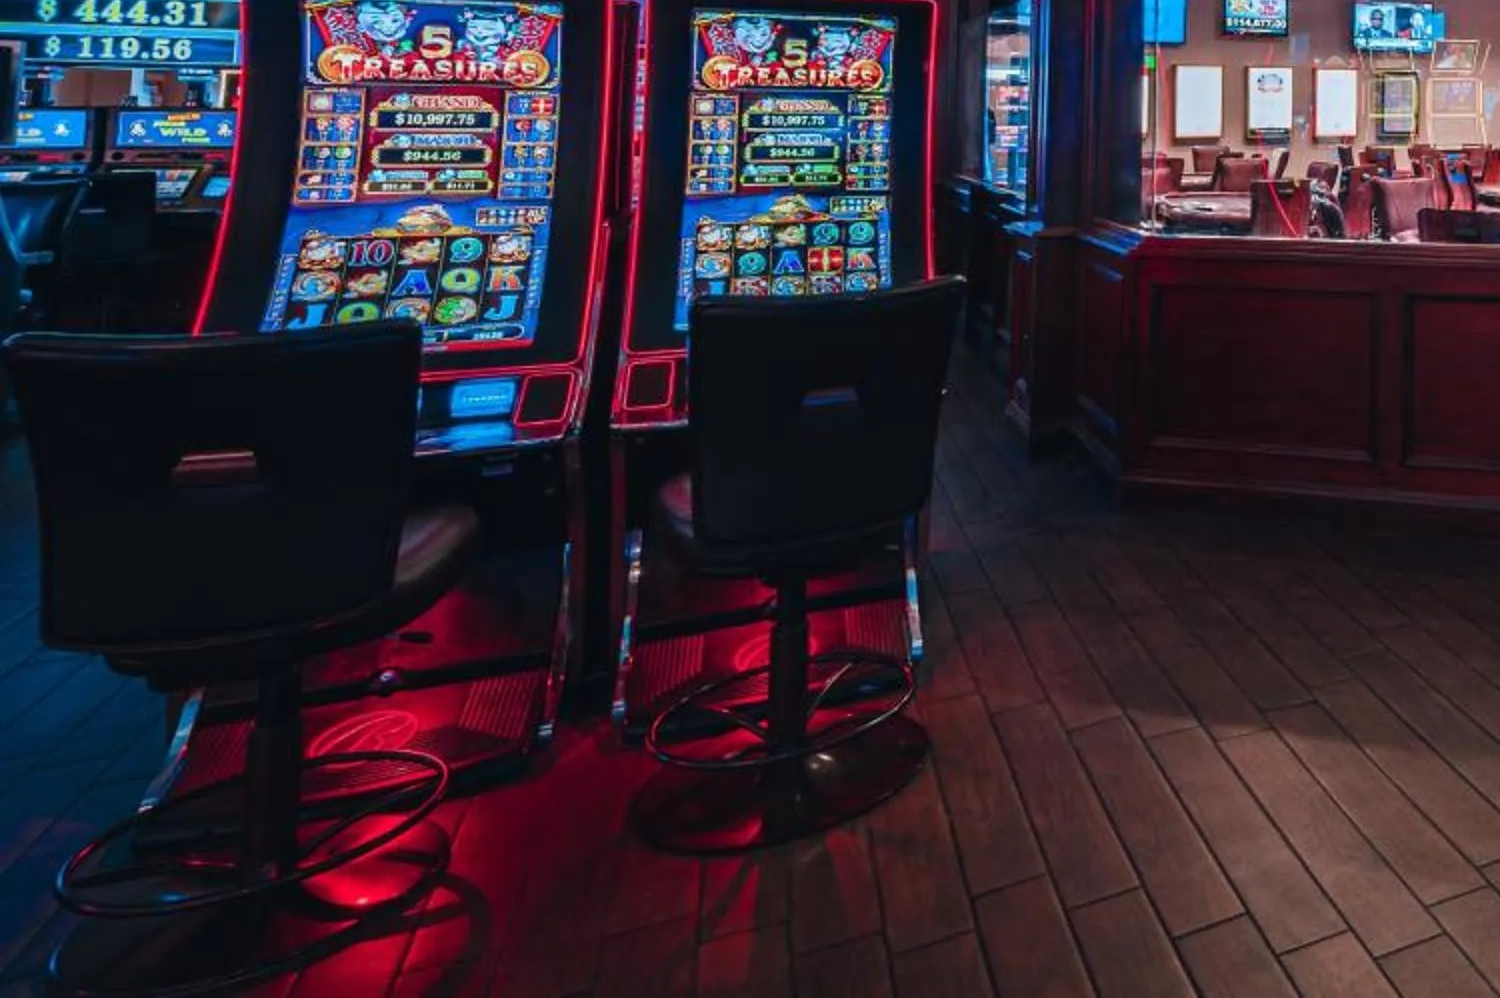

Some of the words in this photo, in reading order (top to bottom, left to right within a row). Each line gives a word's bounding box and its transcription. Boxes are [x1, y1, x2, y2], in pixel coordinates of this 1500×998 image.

[77, 36, 192, 59] 119.56
[420, 25, 452, 58] 5
[782, 39, 808, 67] 5
[332, 52, 539, 82] TREASURES
[713, 62, 874, 88] TREASURES
[349, 239, 395, 266] 10
[450, 237, 484, 262] 9
[773, 250, 805, 274] A
[392, 270, 432, 295] A
[441, 267, 481, 293] Q
[486, 265, 524, 292] K
[484, 294, 519, 321] J
